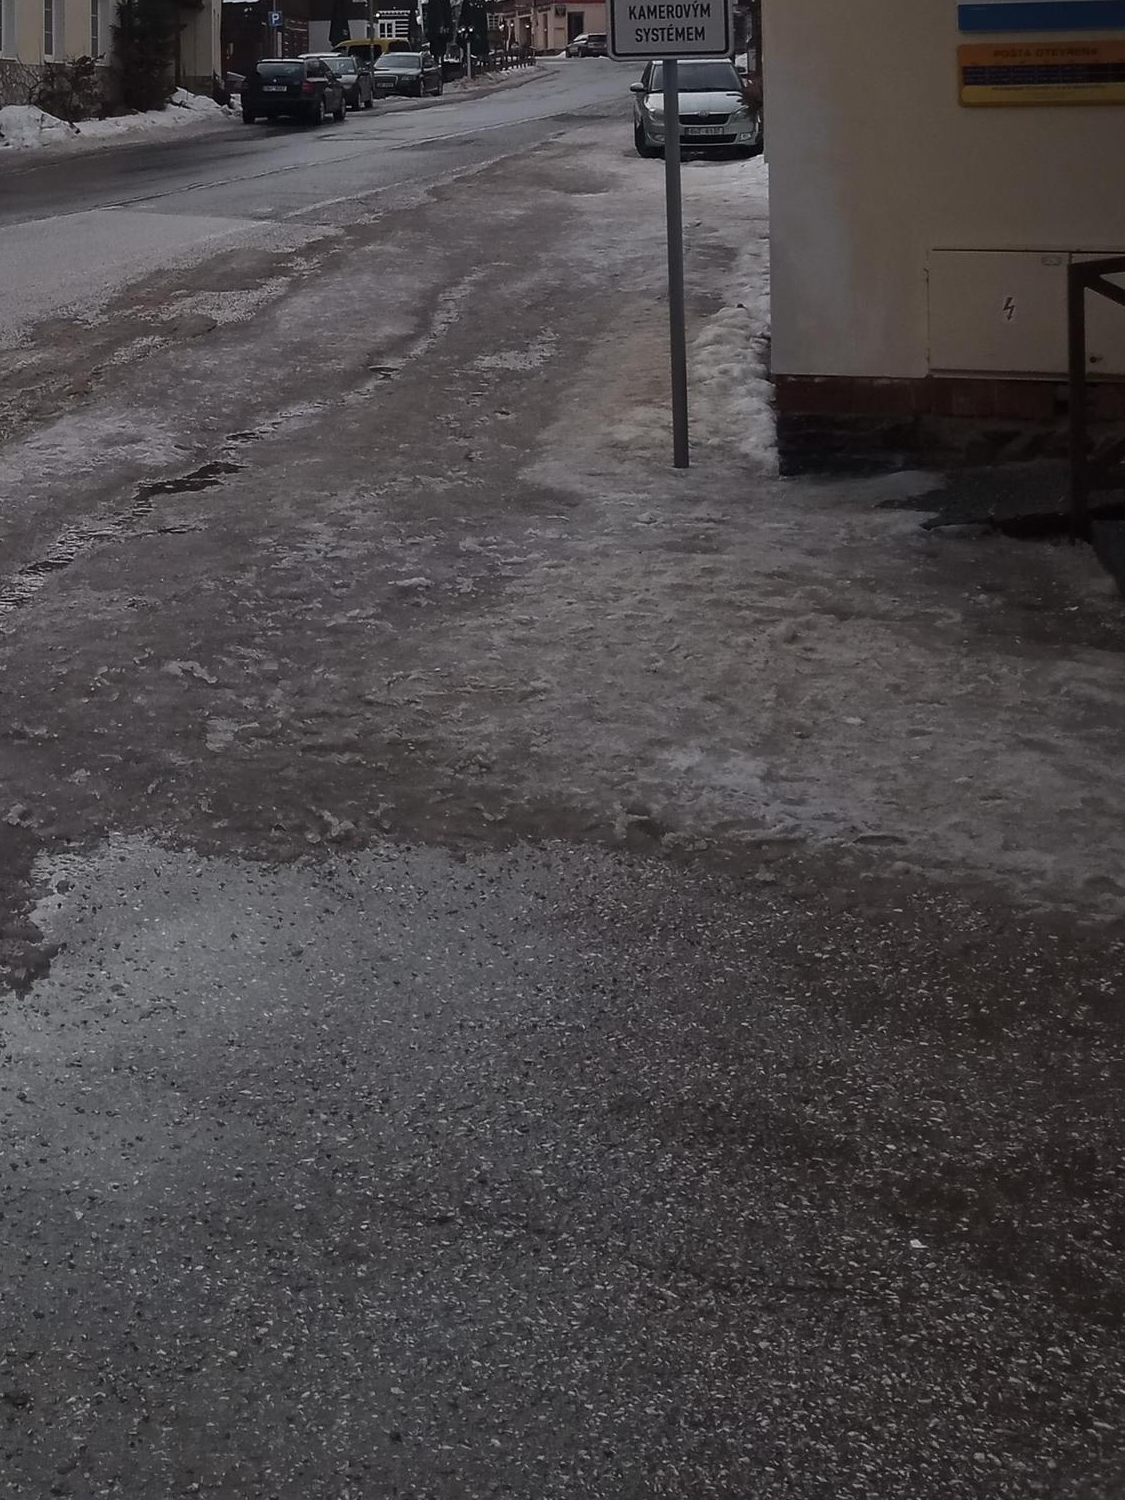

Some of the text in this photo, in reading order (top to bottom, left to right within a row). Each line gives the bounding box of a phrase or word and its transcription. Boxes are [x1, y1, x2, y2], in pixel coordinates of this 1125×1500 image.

[271, 13, 280, 26] P
[628, 1, 711, 20] KAMEROVÝM
[635, 24, 705, 43] SYSTÉMEM
